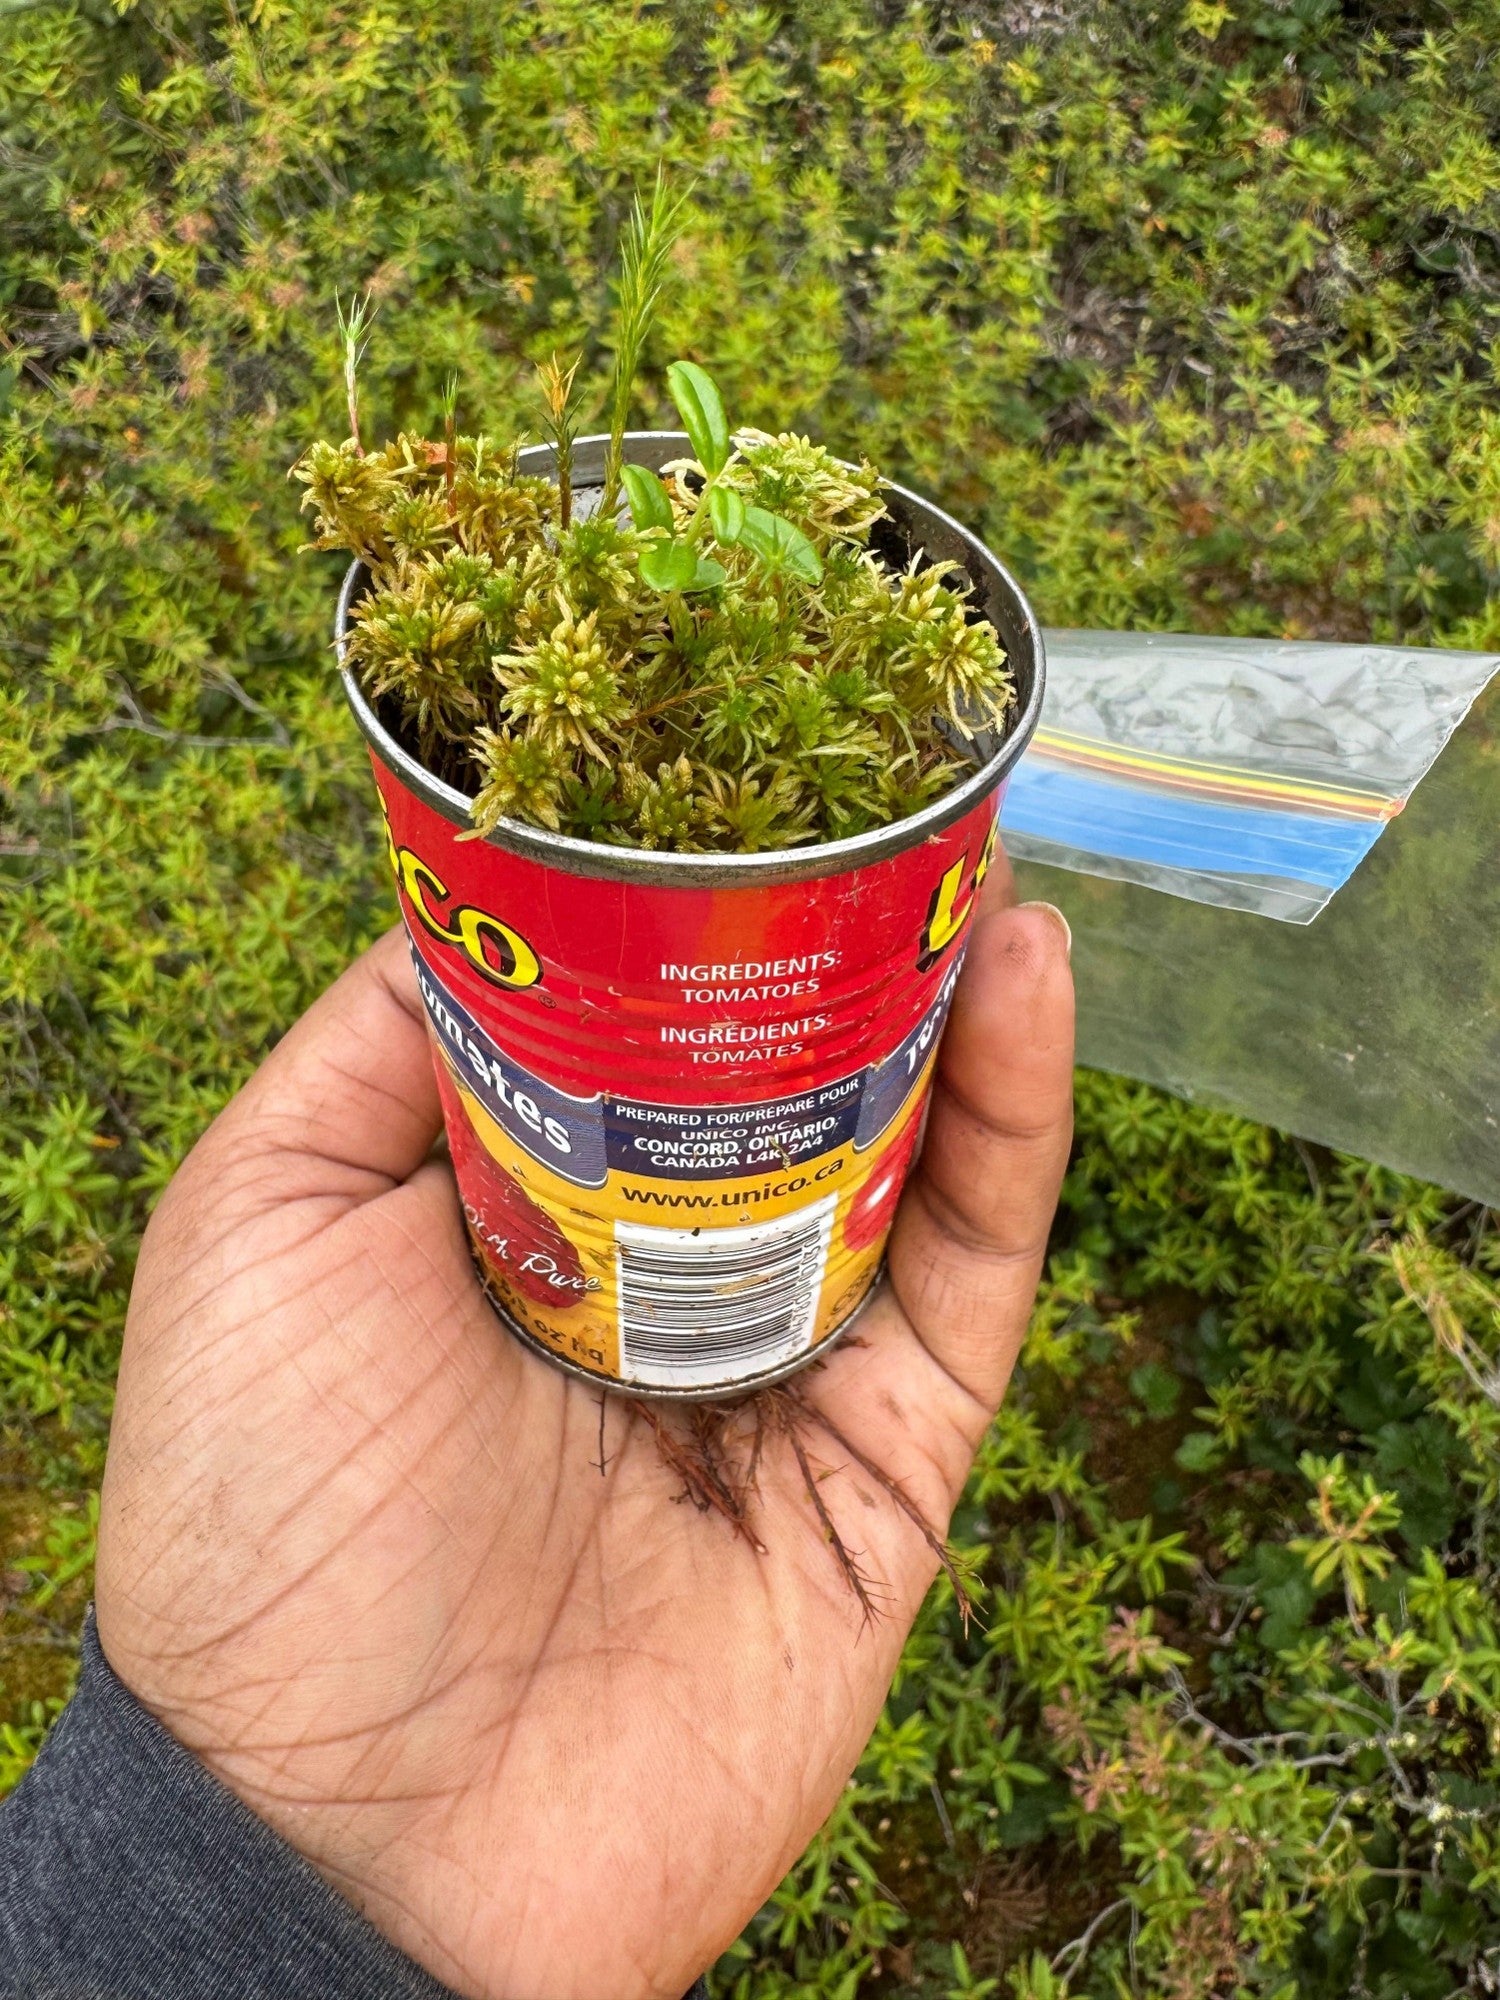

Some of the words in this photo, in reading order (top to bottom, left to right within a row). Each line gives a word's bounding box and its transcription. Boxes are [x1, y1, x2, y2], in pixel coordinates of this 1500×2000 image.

[660, 950, 843, 982] INGREDIENTS:
[681, 978, 821, 1004] TOMATOES
[660, 1013, 833, 1044] INGRÉDIENTS:
[688, 1041, 804, 1064] TOMATES
[615, 1105, 701, 1126] PREPARED
[819, 1078, 860, 1104] POUR
[634, 1137, 742, 1156] CONCORD,
[681, 1128, 748, 1141] UNICO
[650, 1155, 740, 1169] CANADA
[745, 1149, 782, 1164] L4K
[788, 1135, 824, 1155] 2A4
[621, 1158, 844, 1208] www.unico.ca
